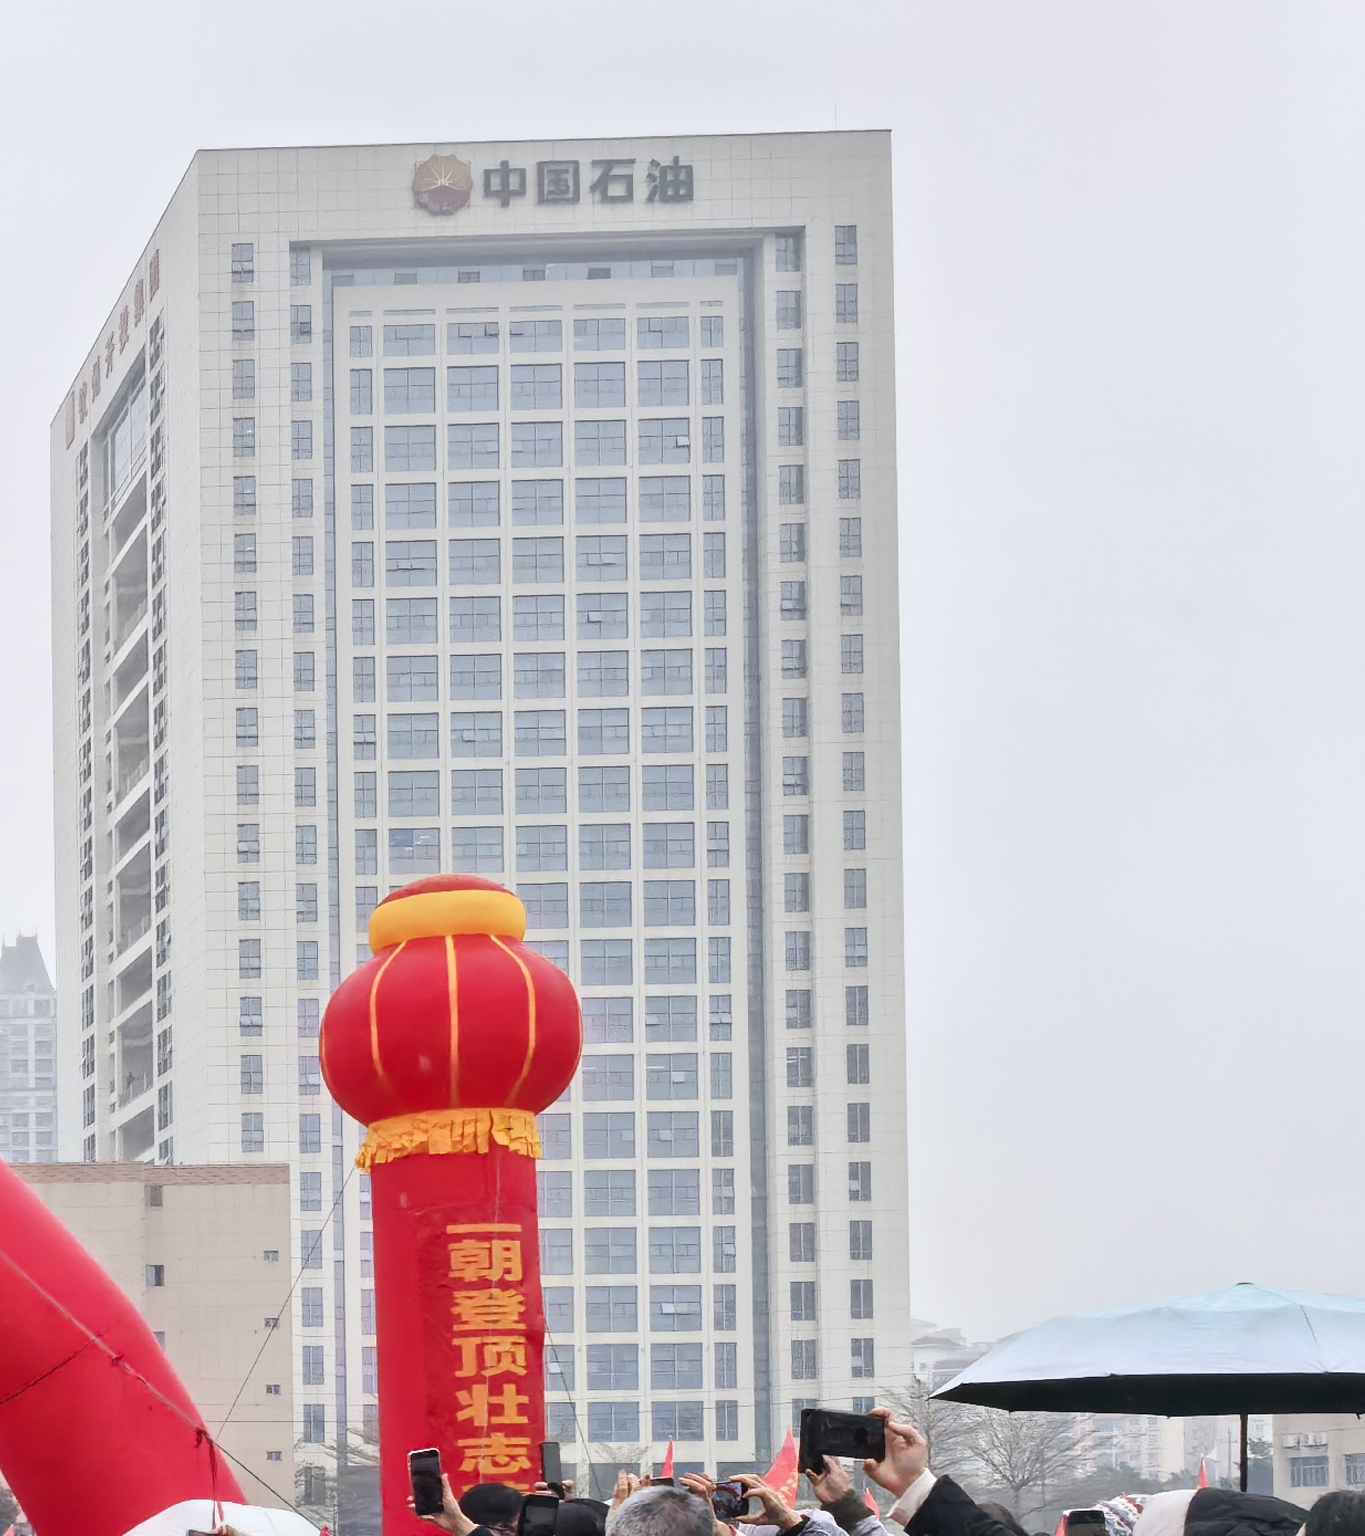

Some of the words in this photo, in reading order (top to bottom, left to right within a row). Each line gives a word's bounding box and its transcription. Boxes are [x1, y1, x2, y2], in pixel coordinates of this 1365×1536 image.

[483, 156, 695, 207] 中国石油
[446, 1223, 532, 1492] 一朝登顶壮志
